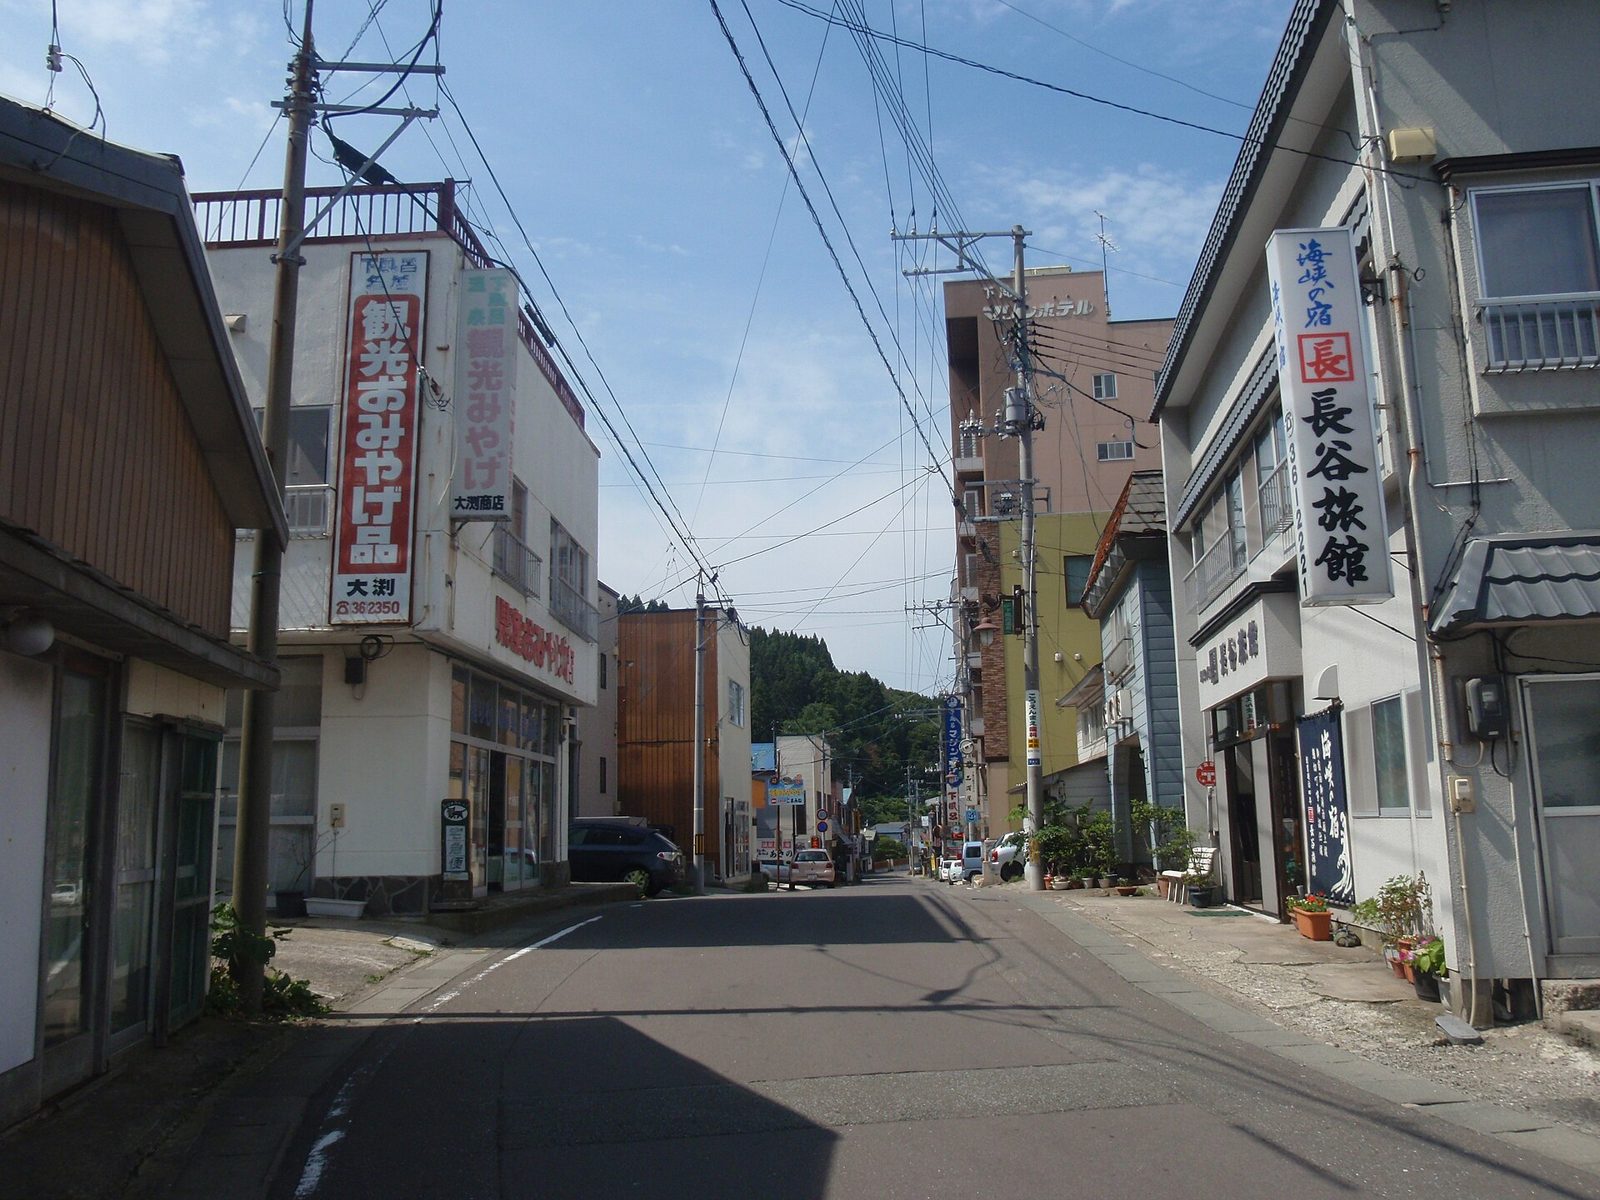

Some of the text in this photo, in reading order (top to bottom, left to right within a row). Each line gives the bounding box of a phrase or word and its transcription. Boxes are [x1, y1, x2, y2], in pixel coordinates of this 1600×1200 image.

[1297, 238, 1335, 328] 海峡の宿
[1306, 339, 1347, 379] 長
[350, 300, 411, 565] 観光おみやげ品
[454, 494, 505, 511] 大渕商店
[1302, 387, 1369, 588] 長谷旅館
[346, 578, 396, 597] 大渕
